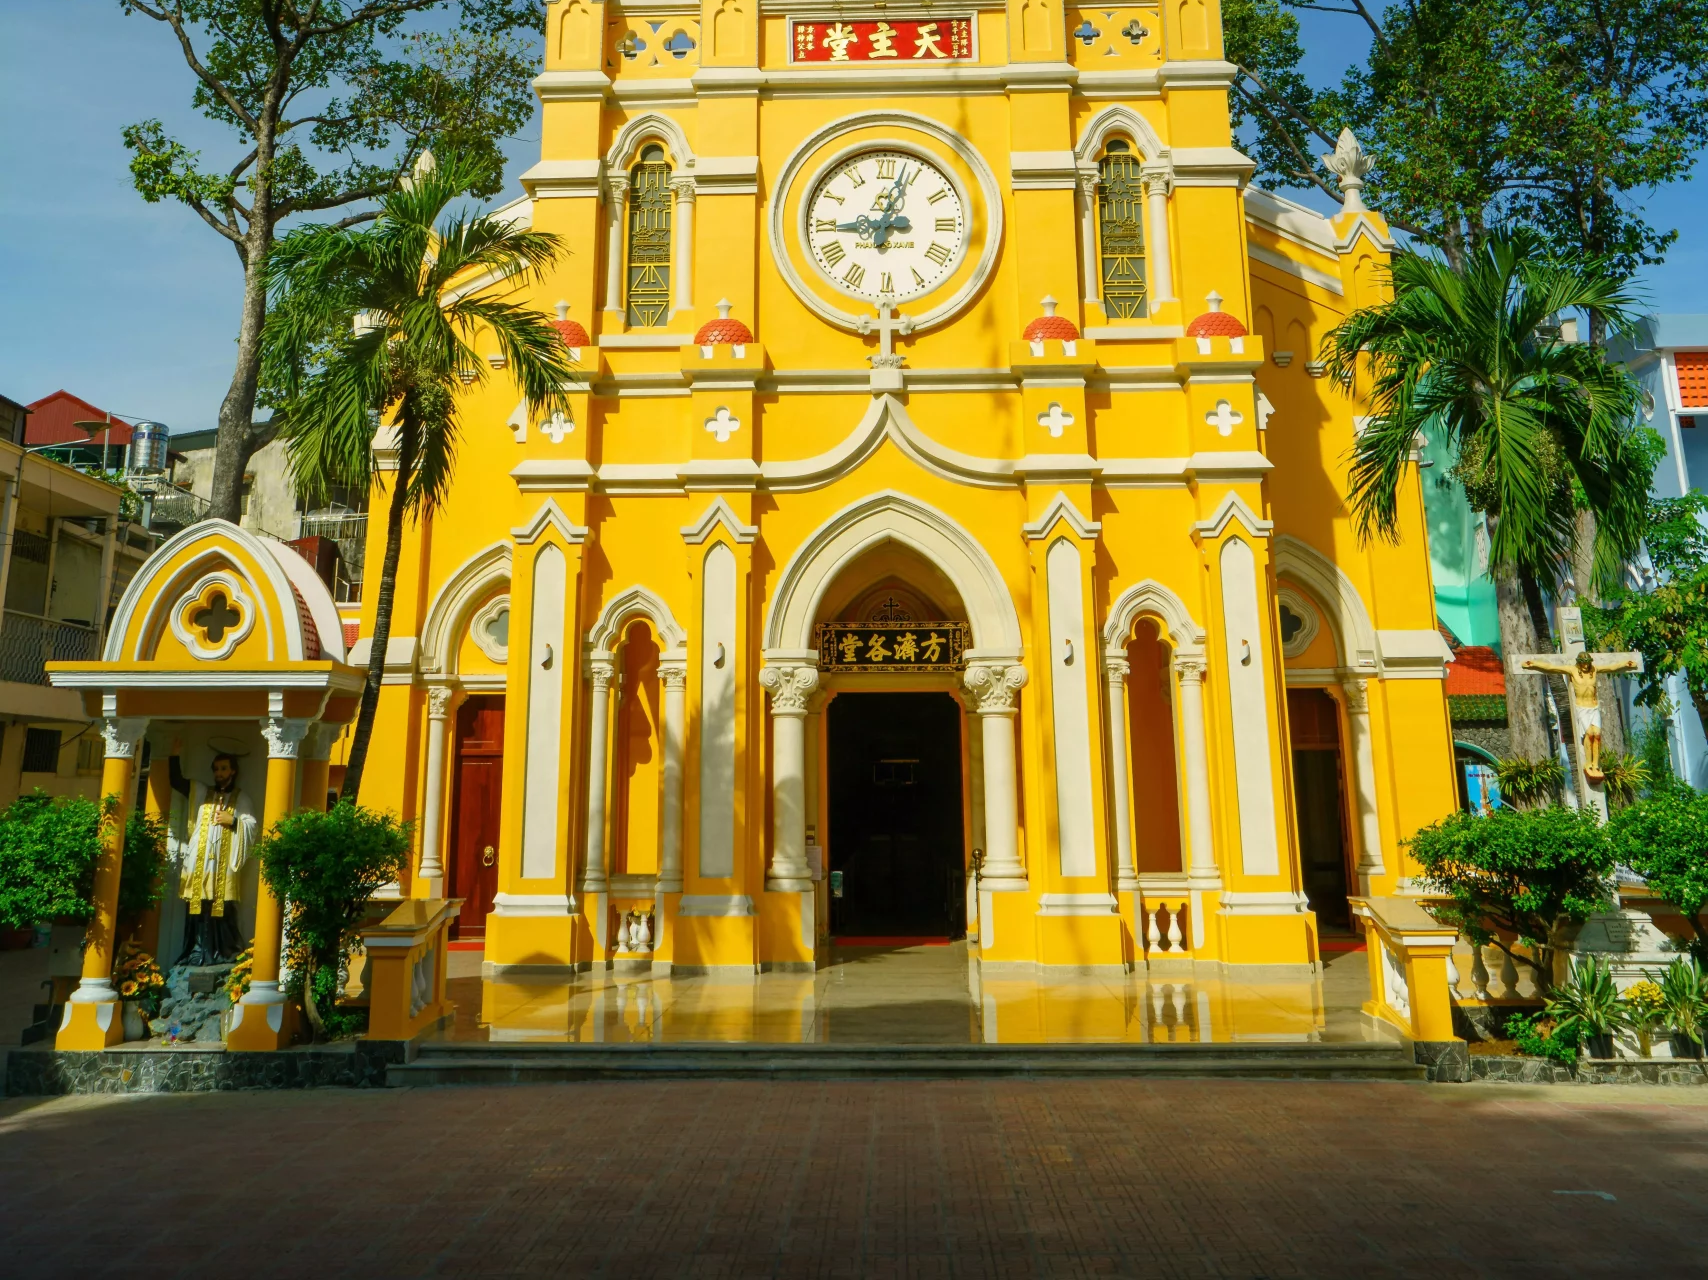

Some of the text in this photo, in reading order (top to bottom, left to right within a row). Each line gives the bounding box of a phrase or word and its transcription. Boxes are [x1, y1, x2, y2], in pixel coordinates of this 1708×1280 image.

[844, 165, 866, 189] XI
[875, 159, 896, 180] XII
[908, 167, 922, 186] I
[823, 188, 845, 206] X
[926, 187, 948, 206] II
[816, 218, 837, 233] IX
[935, 217, 956, 233] III
[820, 239, 846, 268] VIII
[842, 262, 866, 288] VII
[880, 272, 895, 293] VI
[910, 265, 925, 286] V
